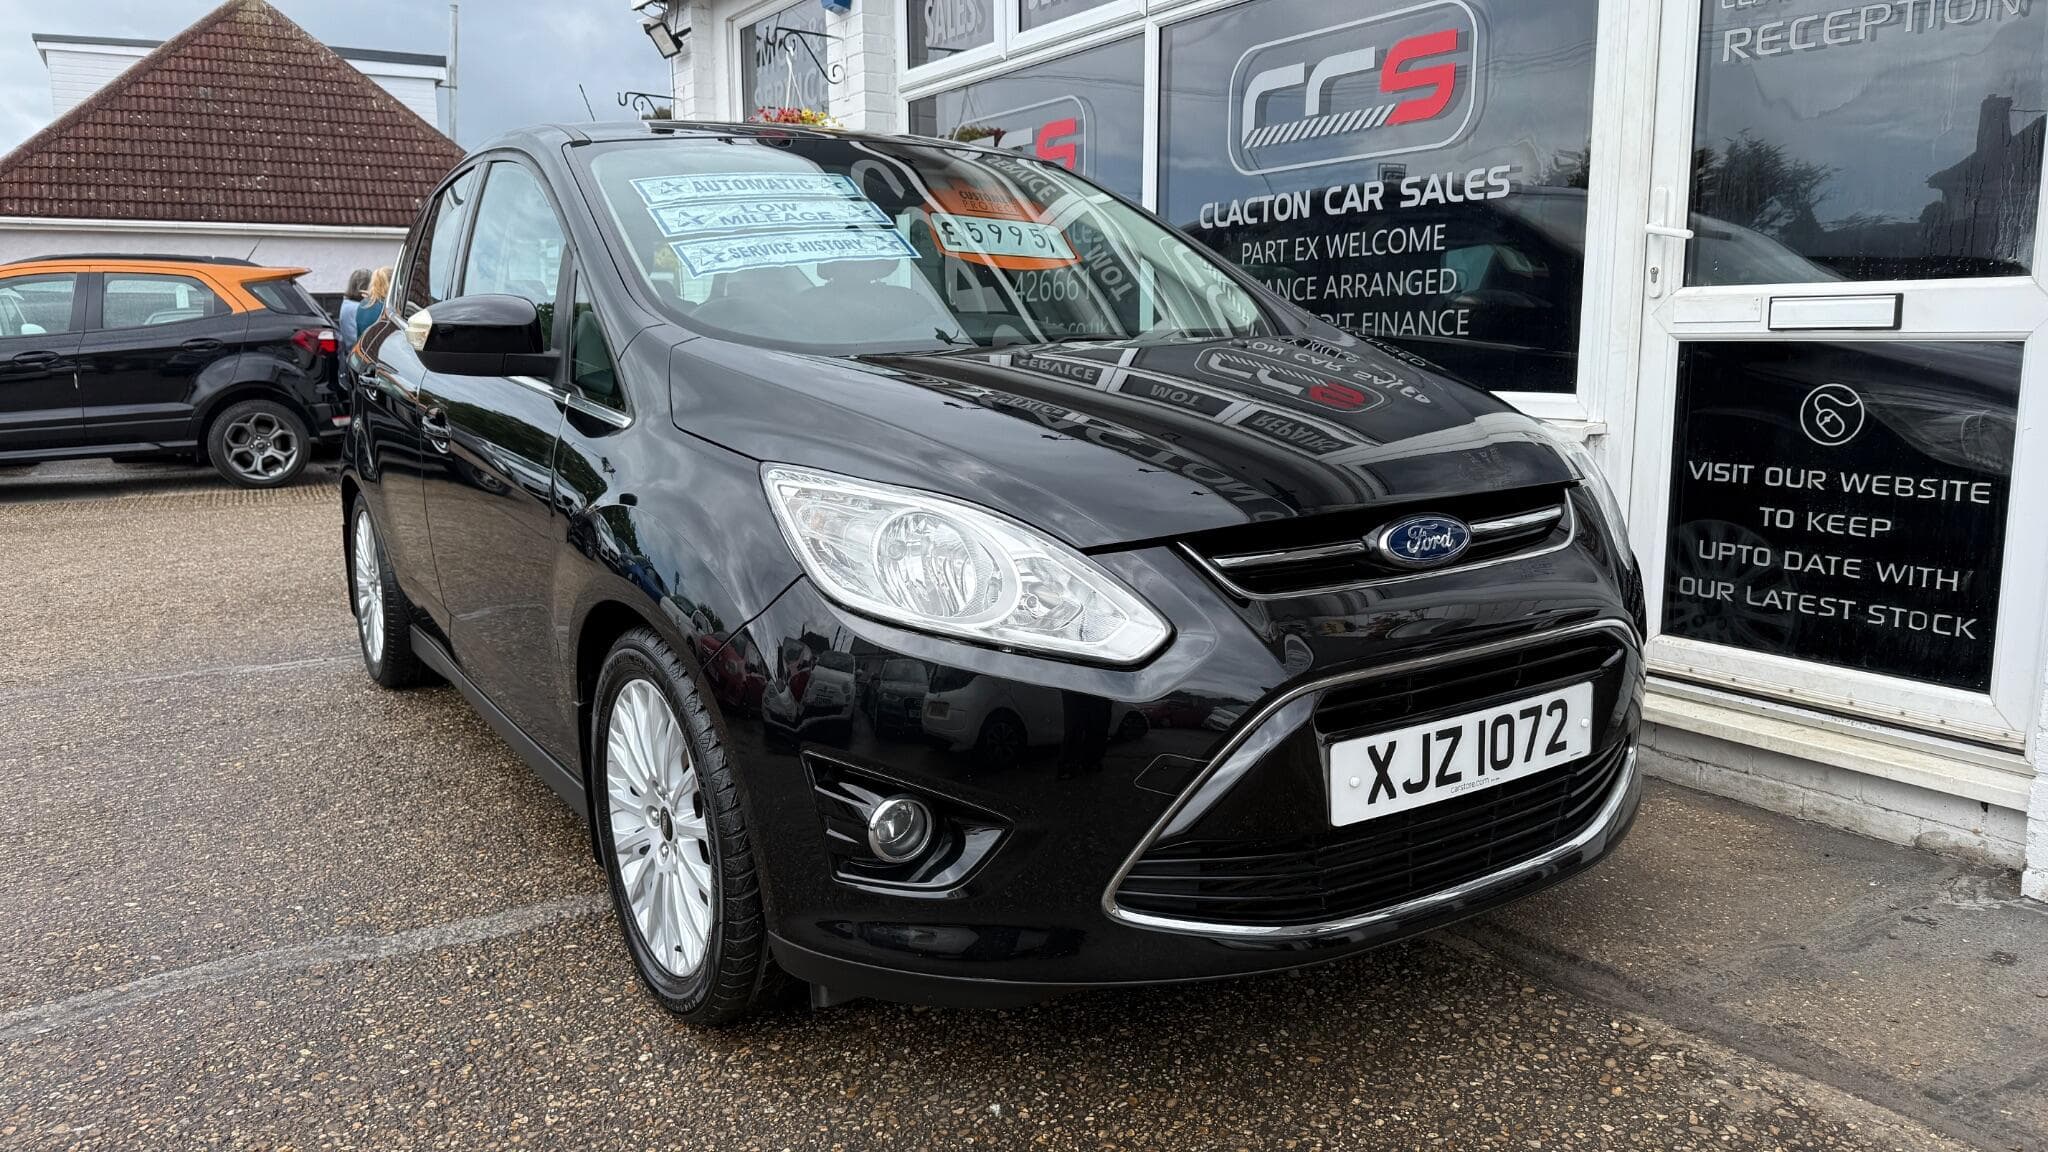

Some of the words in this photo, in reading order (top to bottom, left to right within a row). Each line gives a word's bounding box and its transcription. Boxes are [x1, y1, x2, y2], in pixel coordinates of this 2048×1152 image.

[692, 177, 814, 194] AUTOMATIC
[1200, 190, 1311, 229] CLACTON
[1324, 181, 1385, 216] CAR
[1400, 164, 1512, 208] SALES
[719, 211, 837, 226] MILEAGE
[740, 202, 798, 214] LOW
[729, 243, 793, 260] SERVICE
[797, 238, 865, 255] HISTORY
[1242, 238, 1289, 265] PART
[1295, 236, 1320, 262] EX
[1325, 224, 1446, 259] WELCOME
[1324, 268, 1458, 300] ARRANGED
[1362, 309, 1470, 337] FINANCE
[1688, 460, 1755, 484] VISIT
[1765, 465, 1827, 491] OUR
[1840, 471, 1992, 504] WEBSITE
[1406, 523, 1454, 554] Ford
[1759, 506, 1794, 529] TO
[1807, 511, 1892, 539] KEEP
[1699, 540, 1772, 567] UPTO
[1783, 551, 1862, 580] DATE
[1876, 561, 1959, 592] WITH
[1679, 576, 1735, 602] OUR
[1746, 586, 1857, 621] LATEST
[1867, 604, 1977, 640] STOCK
[1367, 725, 1463, 805] XJZ
[1477, 699, 1568, 777] 1072
[1450, 777, 1490, 794] carstore.com
